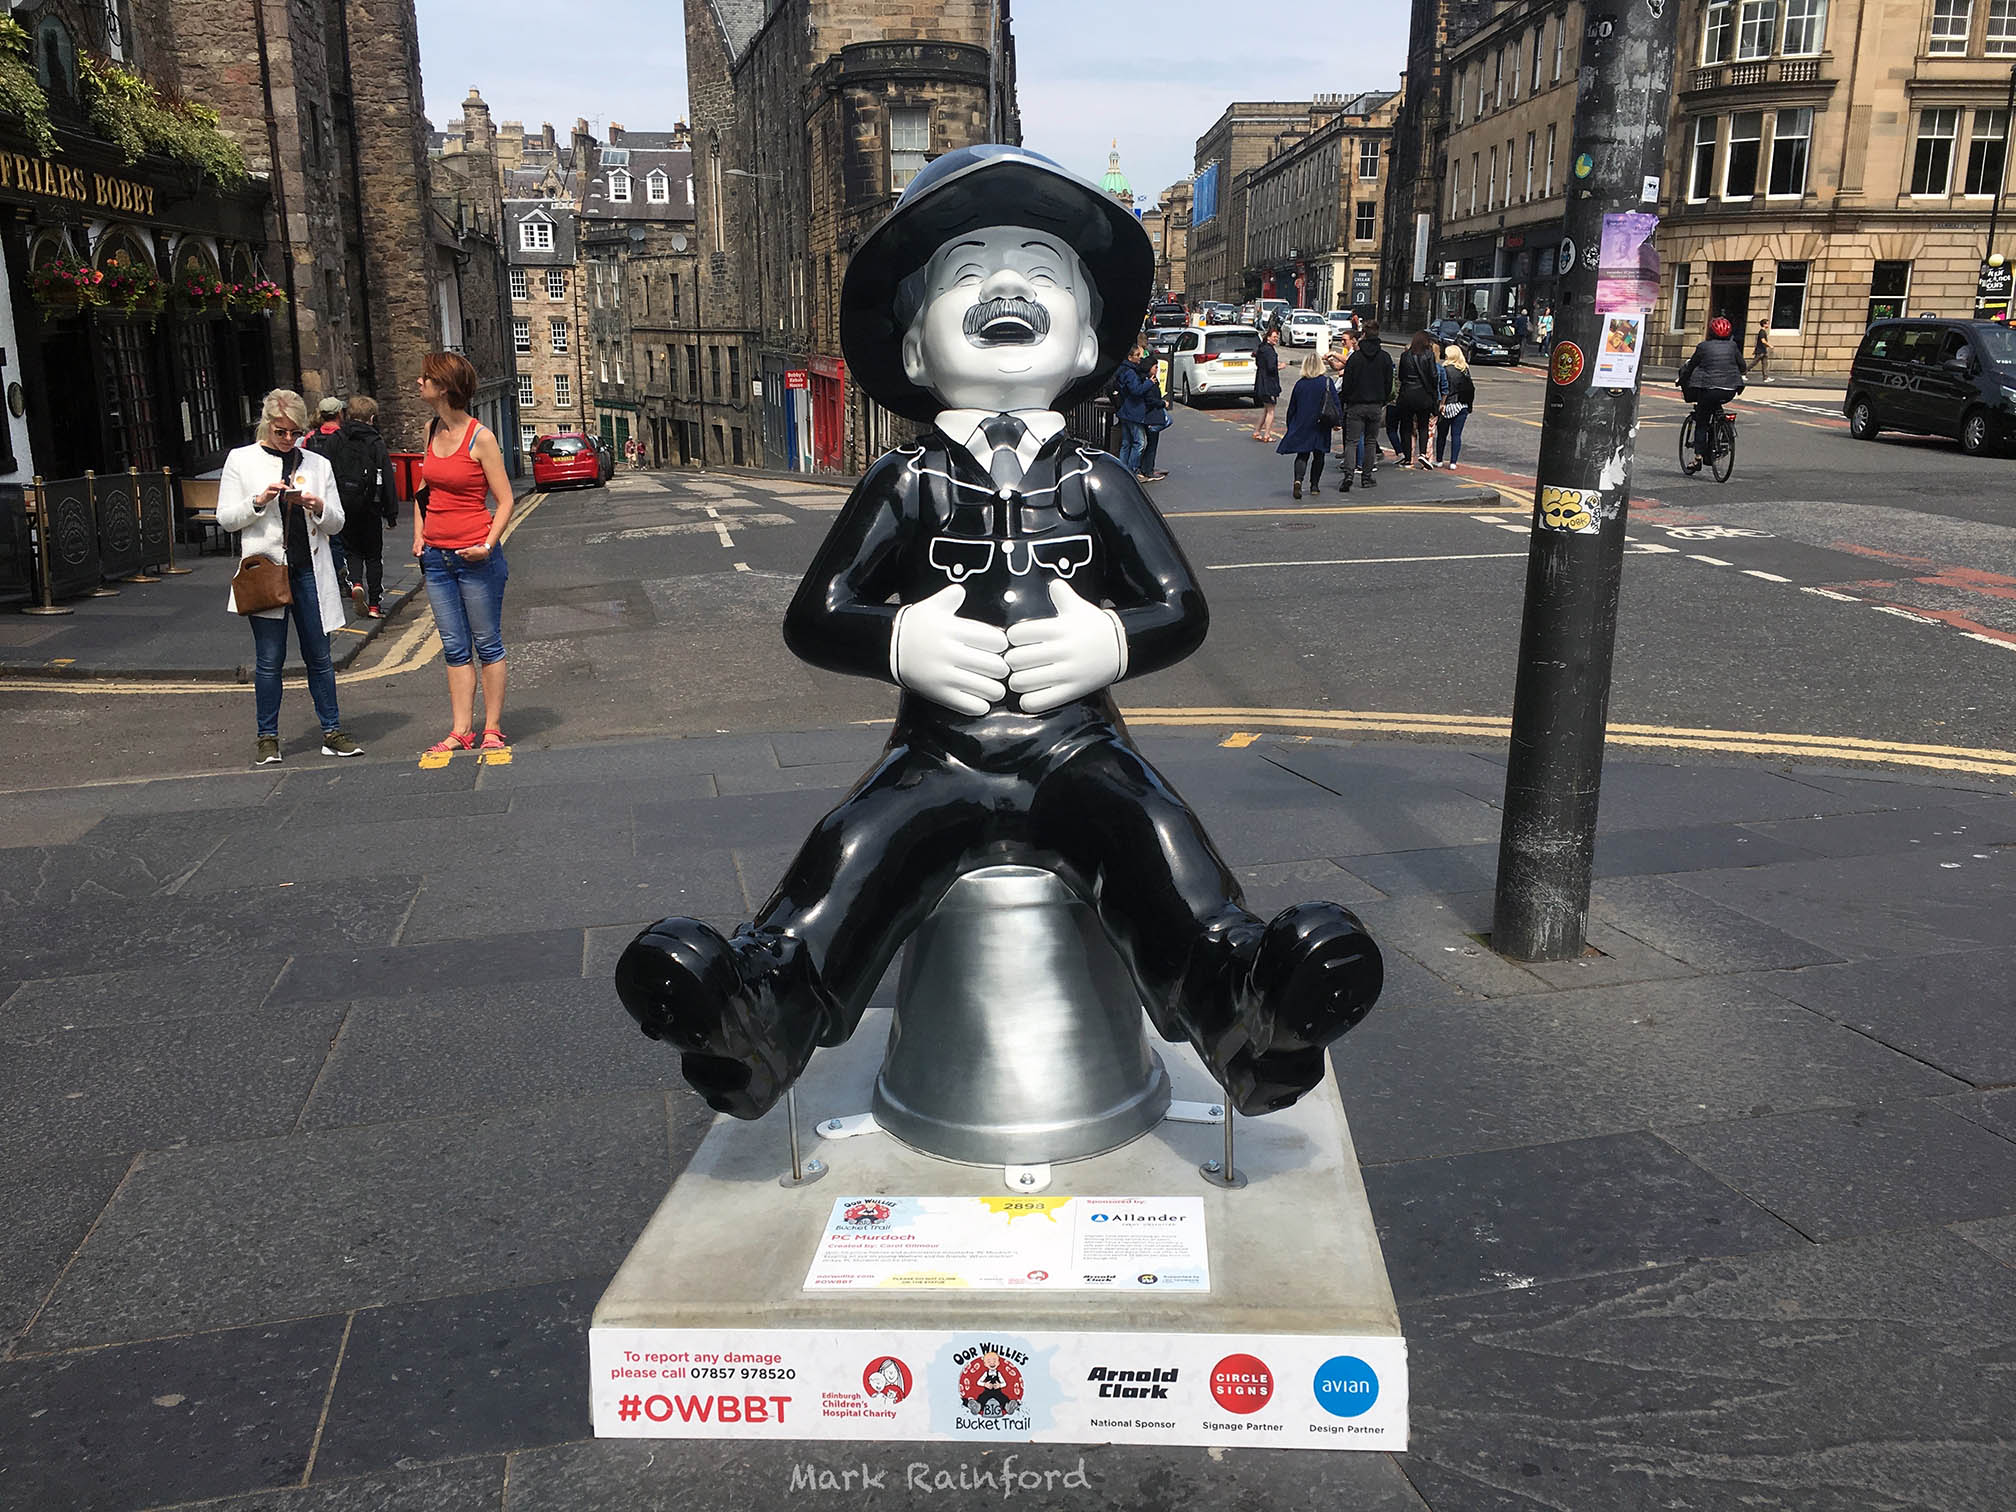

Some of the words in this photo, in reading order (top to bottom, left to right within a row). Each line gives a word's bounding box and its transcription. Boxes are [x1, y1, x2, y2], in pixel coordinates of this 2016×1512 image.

[94, 172, 155, 216] BOBBY
[1112, 1214, 1187, 1222] Allander
[624, 1351, 640, 1362] To
[645, 1352, 689, 1364] report
[694, 1353, 719, 1365] any
[724, 1352, 782, 1365] damage
[953, 1347, 978, 1366] OOR
[611, 1367, 657, 1380] please
[662, 1367, 686, 1378] call
[691, 1368, 735, 1379] 07857
[741, 1368, 796, 1379] 978520
[1087, 1367, 1179, 1382] Arnold
[1216, 1373, 1268, 1383] CIRCLE
[1099, 1384, 1168, 1399] Clark
[1216, 1386, 1268, 1395] SIGNS
[1322, 1380, 1370, 1393] avian
[618, 1394, 792, 1423] #OWBBT
[822, 1400, 868, 1408] Children's
[984, 1404, 1001, 1415] BIG
[822, 1409, 861, 1419] Hospital
[863, 1410, 897, 1419] Charity
[956, 1417, 1000, 1430] Bucket
[1002, 1417, 1031, 1430] Trail
[1090, 1419, 1132, 1427] National
[1135, 1419, 1176, 1429] Sponsor
[1202, 1421, 1243, 1431] Signage
[1246, 1422, 1284, 1431] Partner
[1309, 1424, 1344, 1434] Design
[1347, 1425, 1385, 1433] Partner
